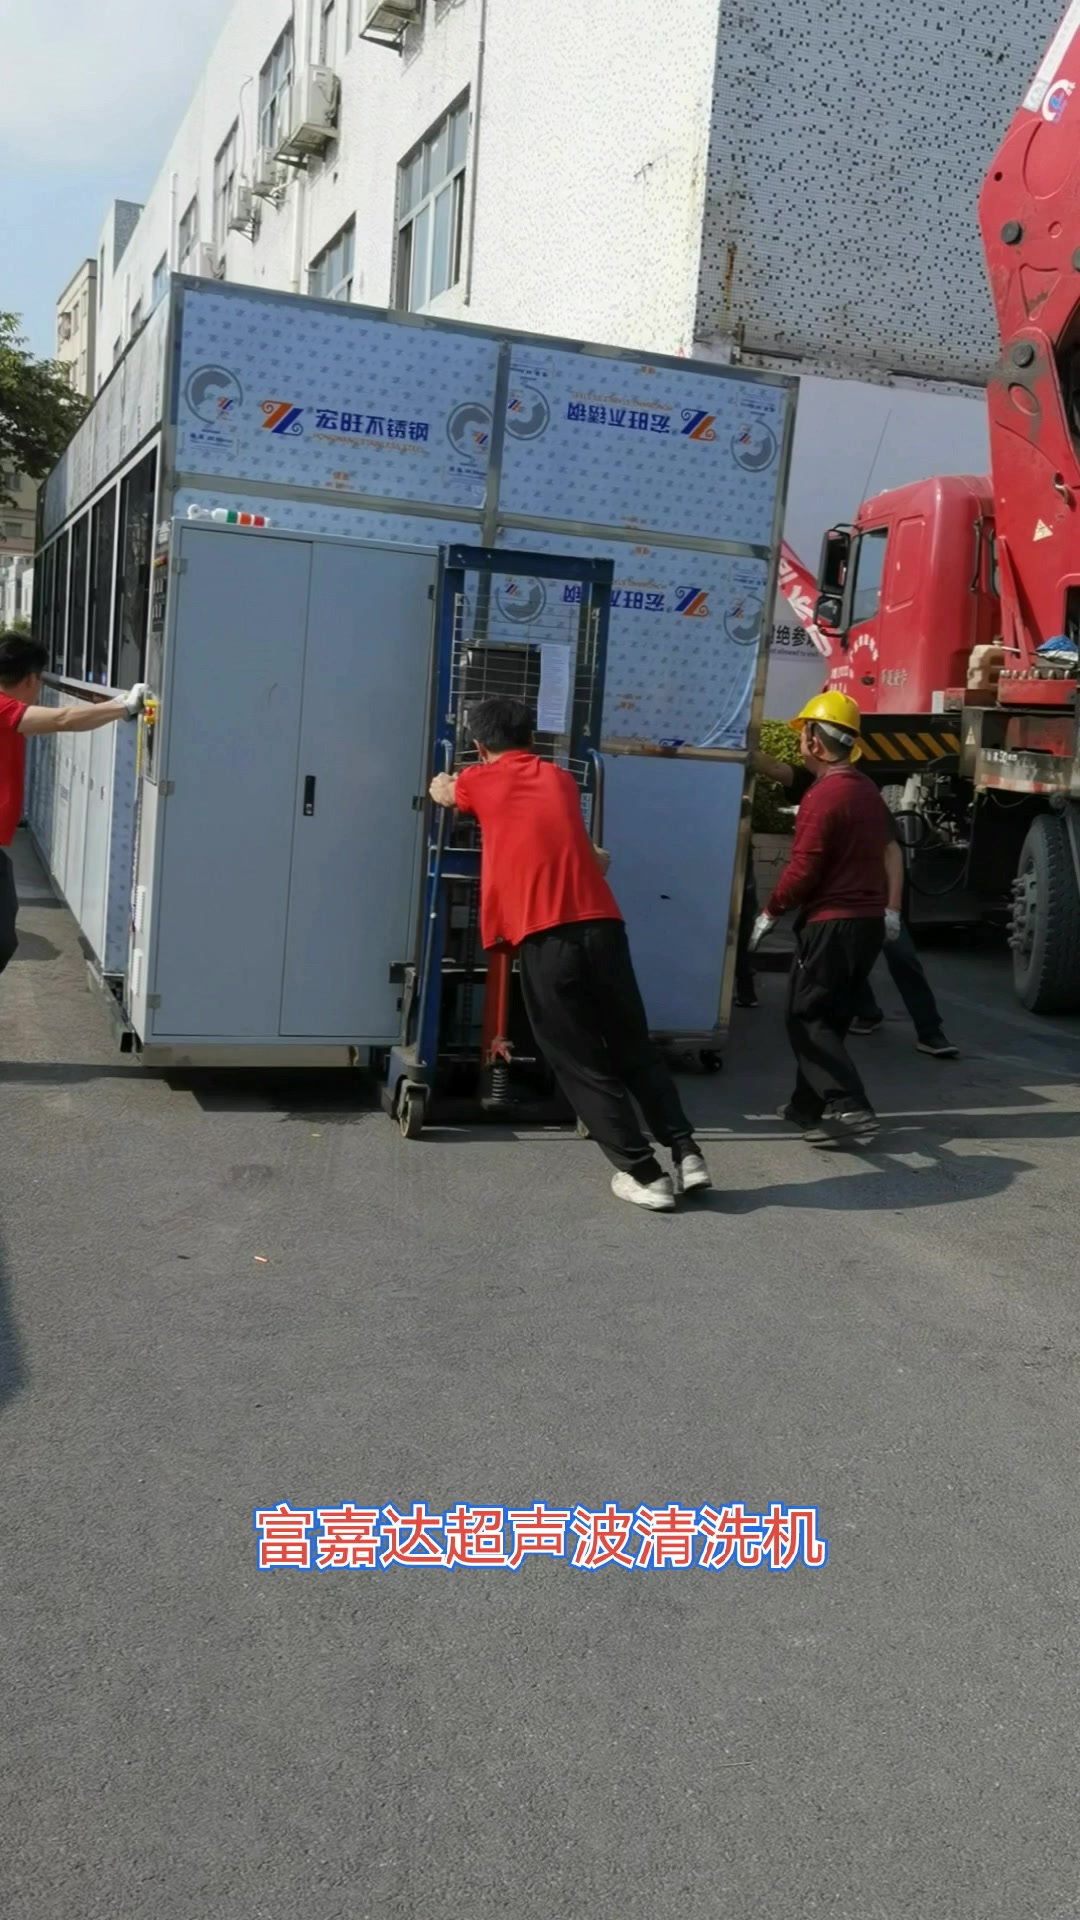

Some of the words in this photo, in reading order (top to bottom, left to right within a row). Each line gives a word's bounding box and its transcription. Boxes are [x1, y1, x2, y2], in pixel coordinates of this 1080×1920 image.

[315, 408, 430, 442] 宏旺不锈钢
[567, 402, 671, 434] 宏旺不锈钢
[563, 585, 665, 612] 宏旺不钢
[771, 624, 815, 648] 绝参
